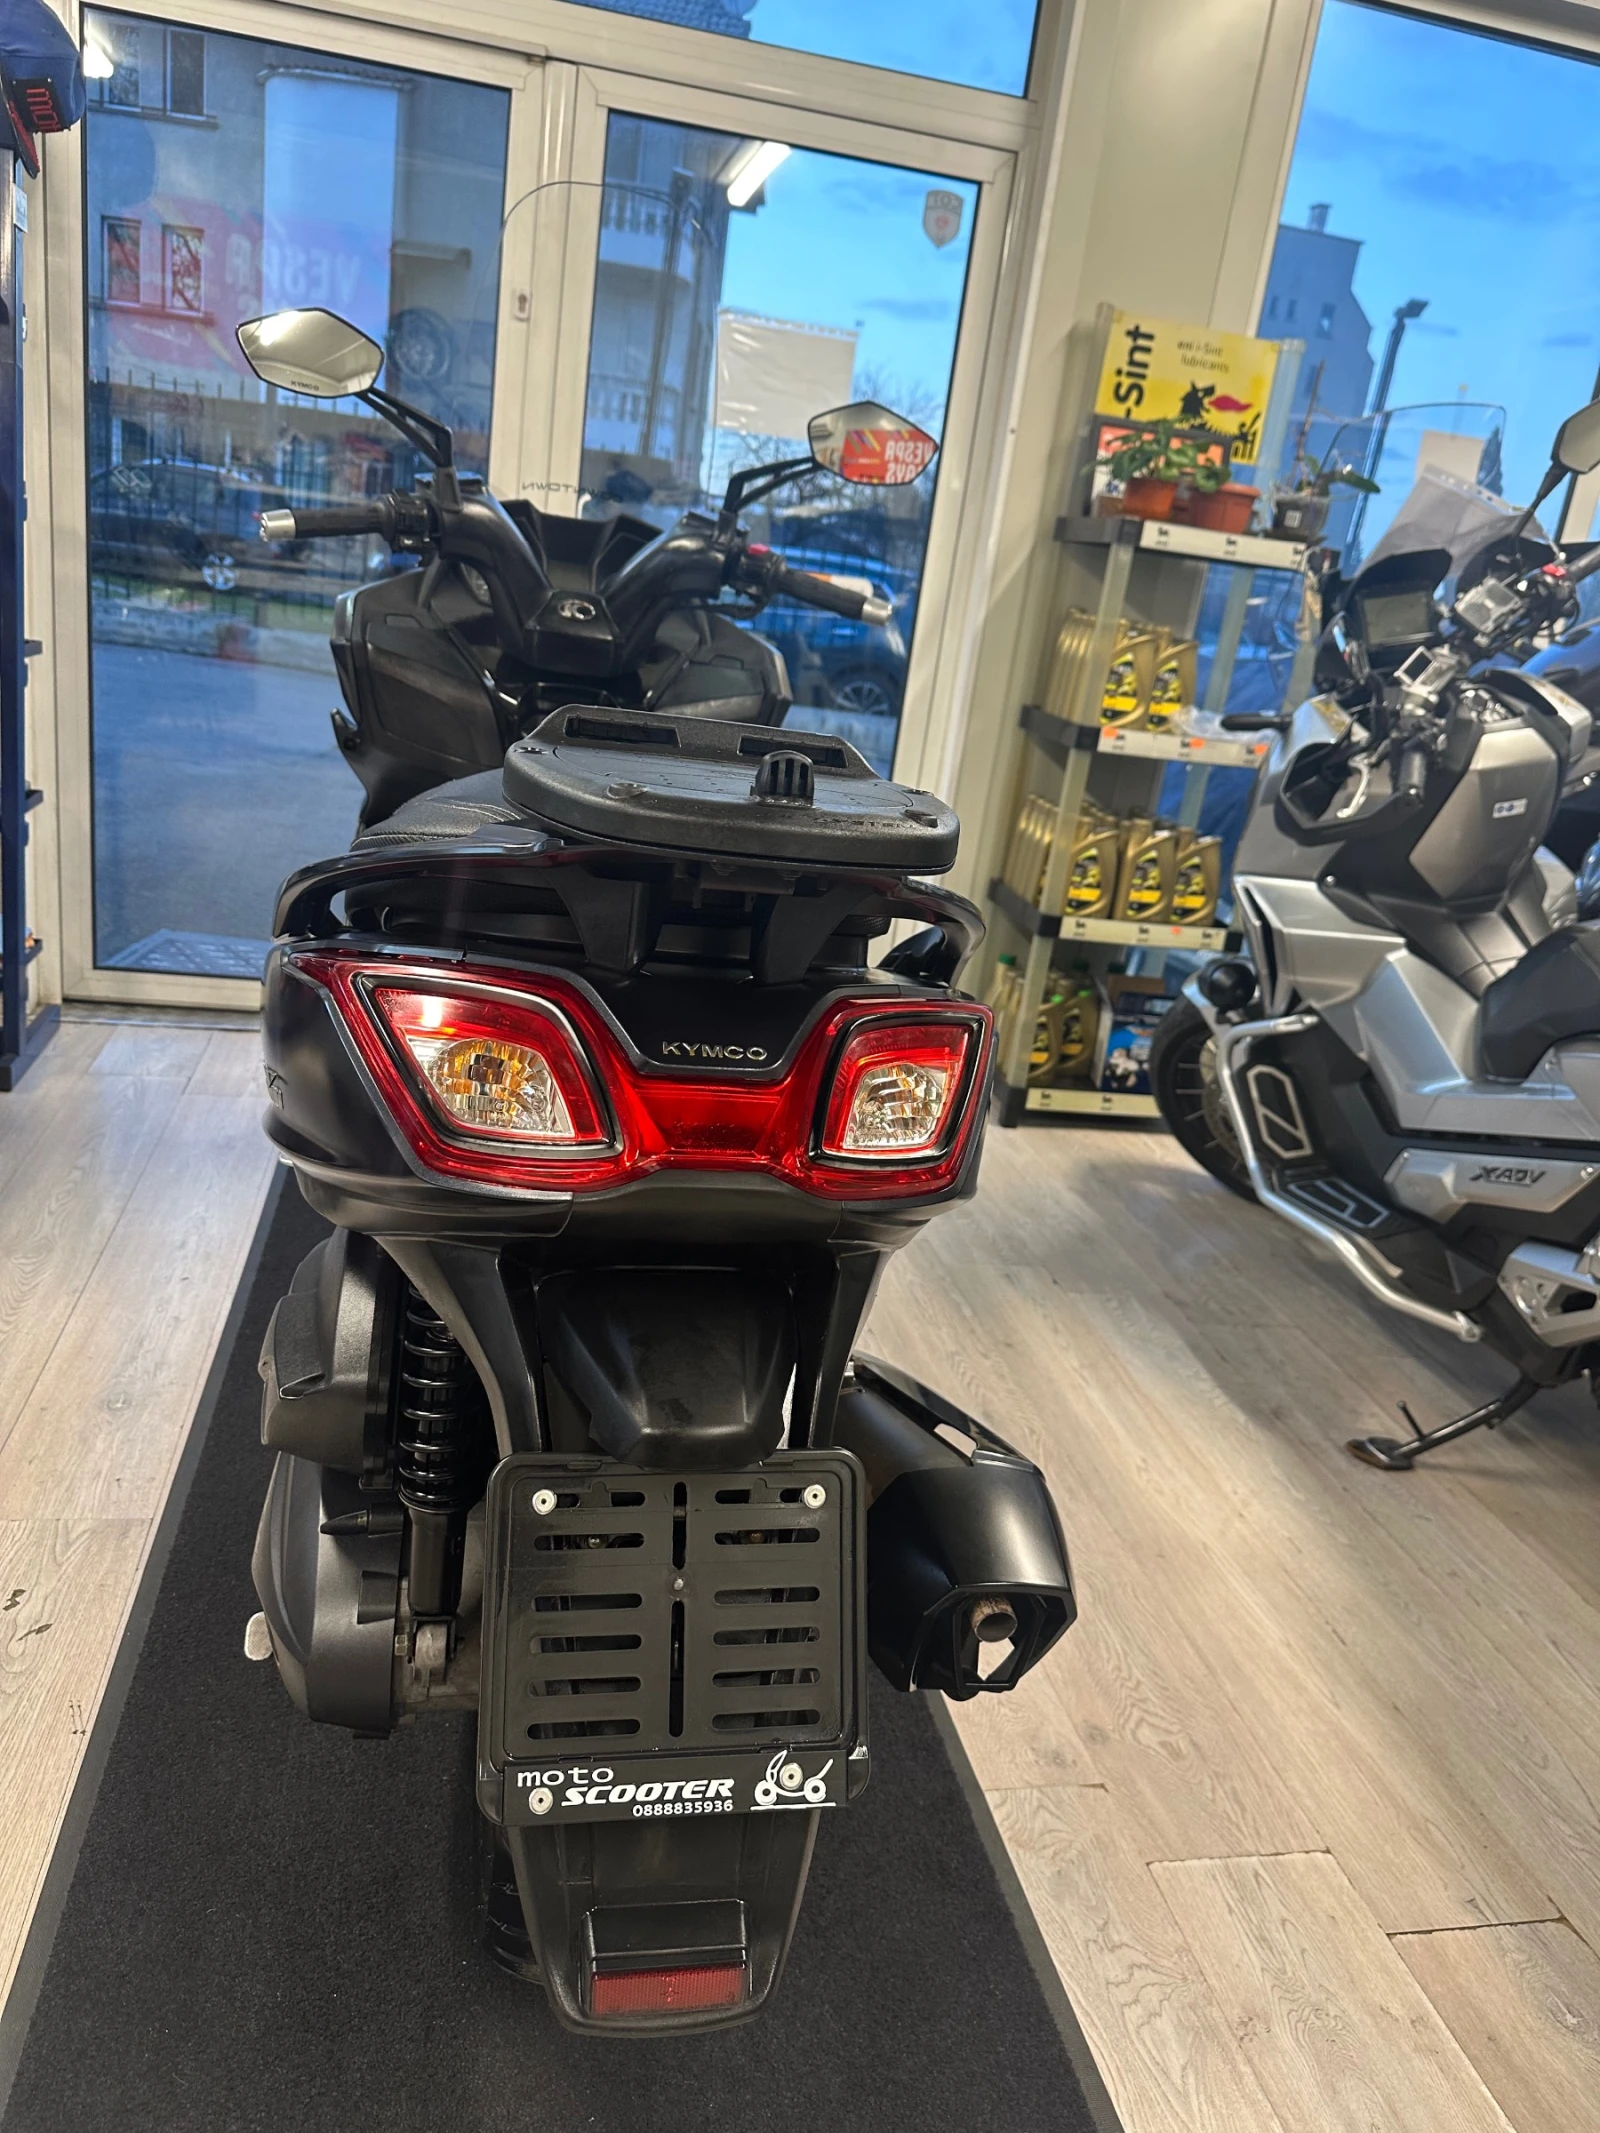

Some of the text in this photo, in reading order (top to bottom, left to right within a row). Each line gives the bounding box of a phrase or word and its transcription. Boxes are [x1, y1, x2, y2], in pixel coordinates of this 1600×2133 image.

[1180, 354, 1230, 373] lubricants
[662, 1040, 768, 1061] KYMCO
[517, 1766, 614, 1788] moto
[561, 1778, 735, 1807] SCOOTER
[632, 1799, 734, 1817] 0888835936
